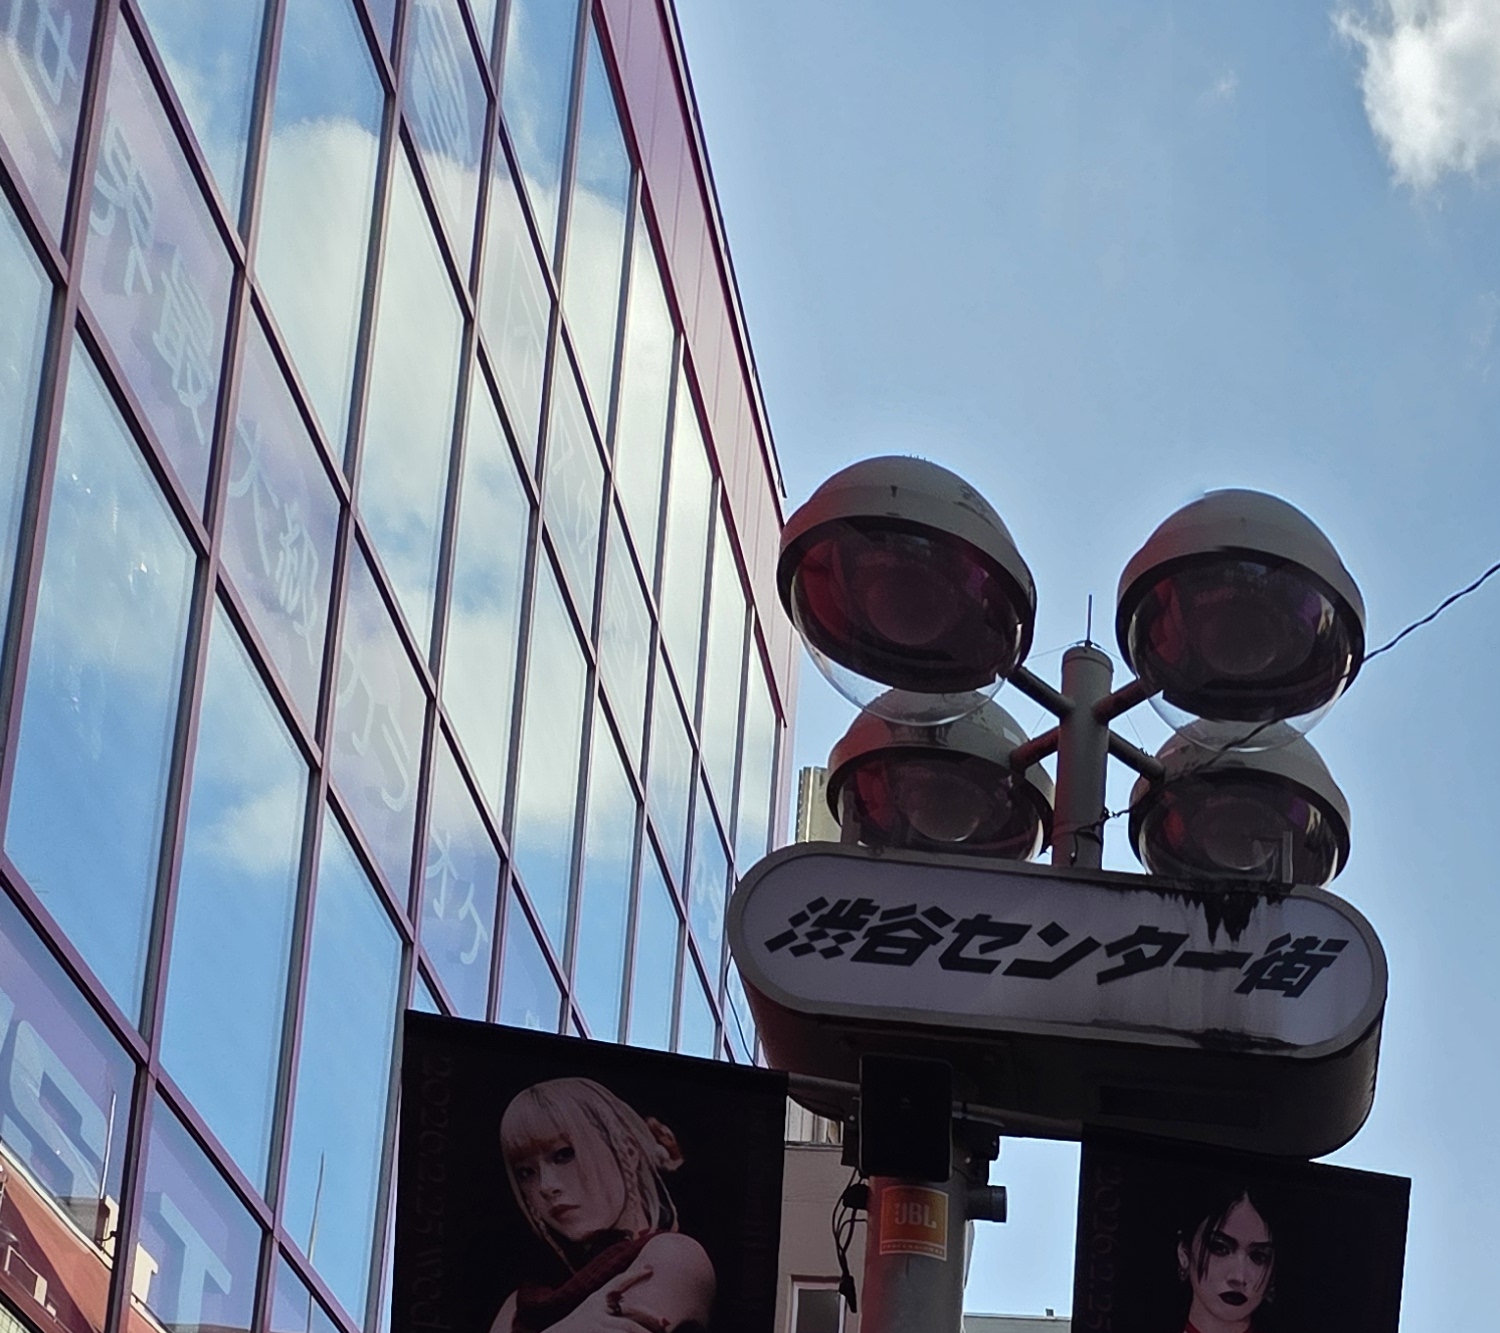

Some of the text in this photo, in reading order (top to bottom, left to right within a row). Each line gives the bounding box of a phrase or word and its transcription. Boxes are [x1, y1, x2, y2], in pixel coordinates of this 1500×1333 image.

[765, 895, 1350, 1001] 渋谷センター街
[894, 1201, 937, 1229] JBL
